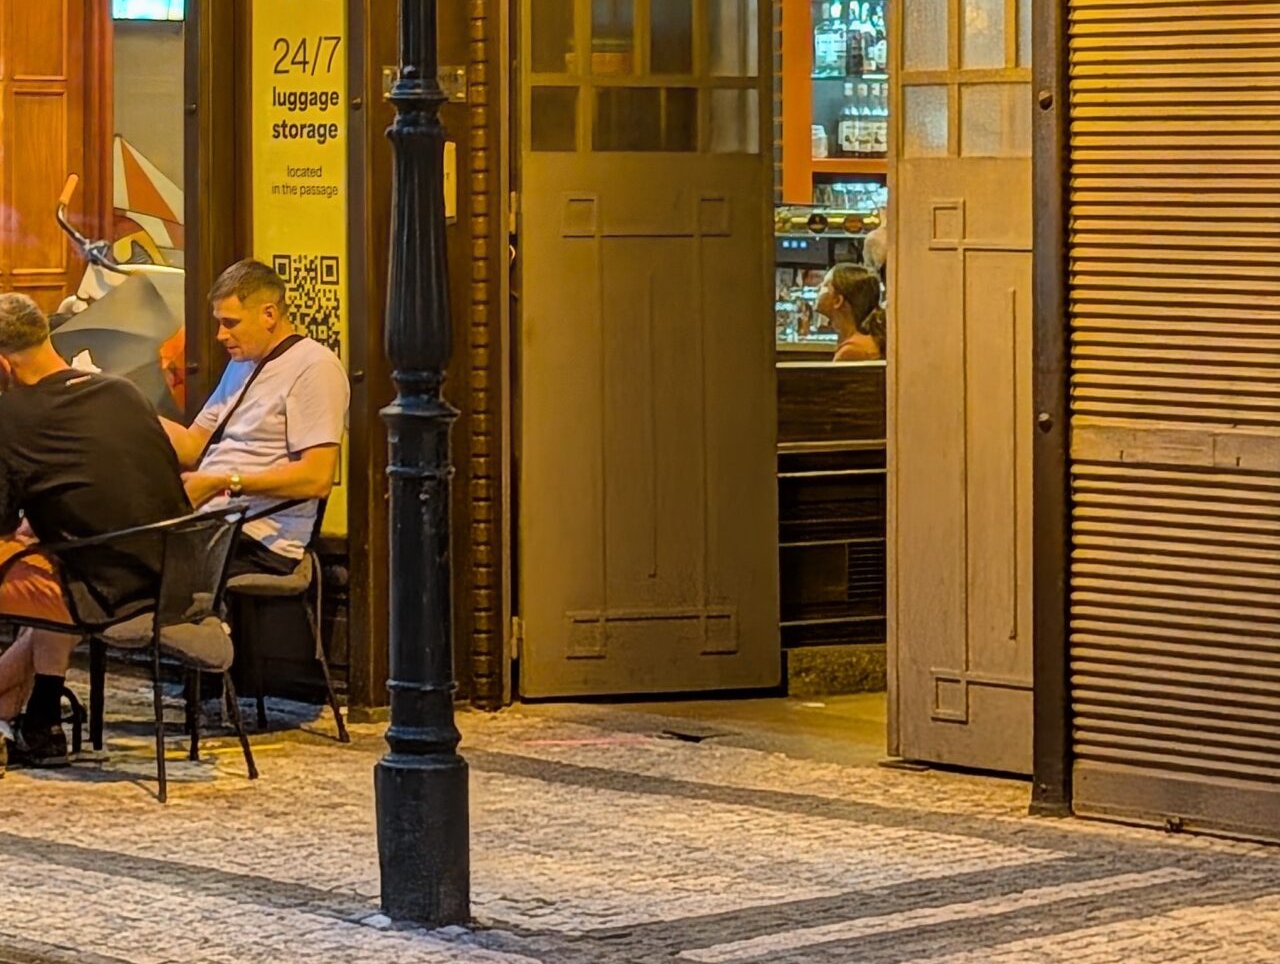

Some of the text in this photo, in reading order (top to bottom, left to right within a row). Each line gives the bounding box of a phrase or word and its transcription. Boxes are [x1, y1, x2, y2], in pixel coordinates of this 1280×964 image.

[273, 36, 342, 76] 24/7
[272, 86, 340, 112] luggage
[272, 119, 339, 145] storage
[287, 164, 322, 178] located
[272, 183, 339, 199] in the passage
